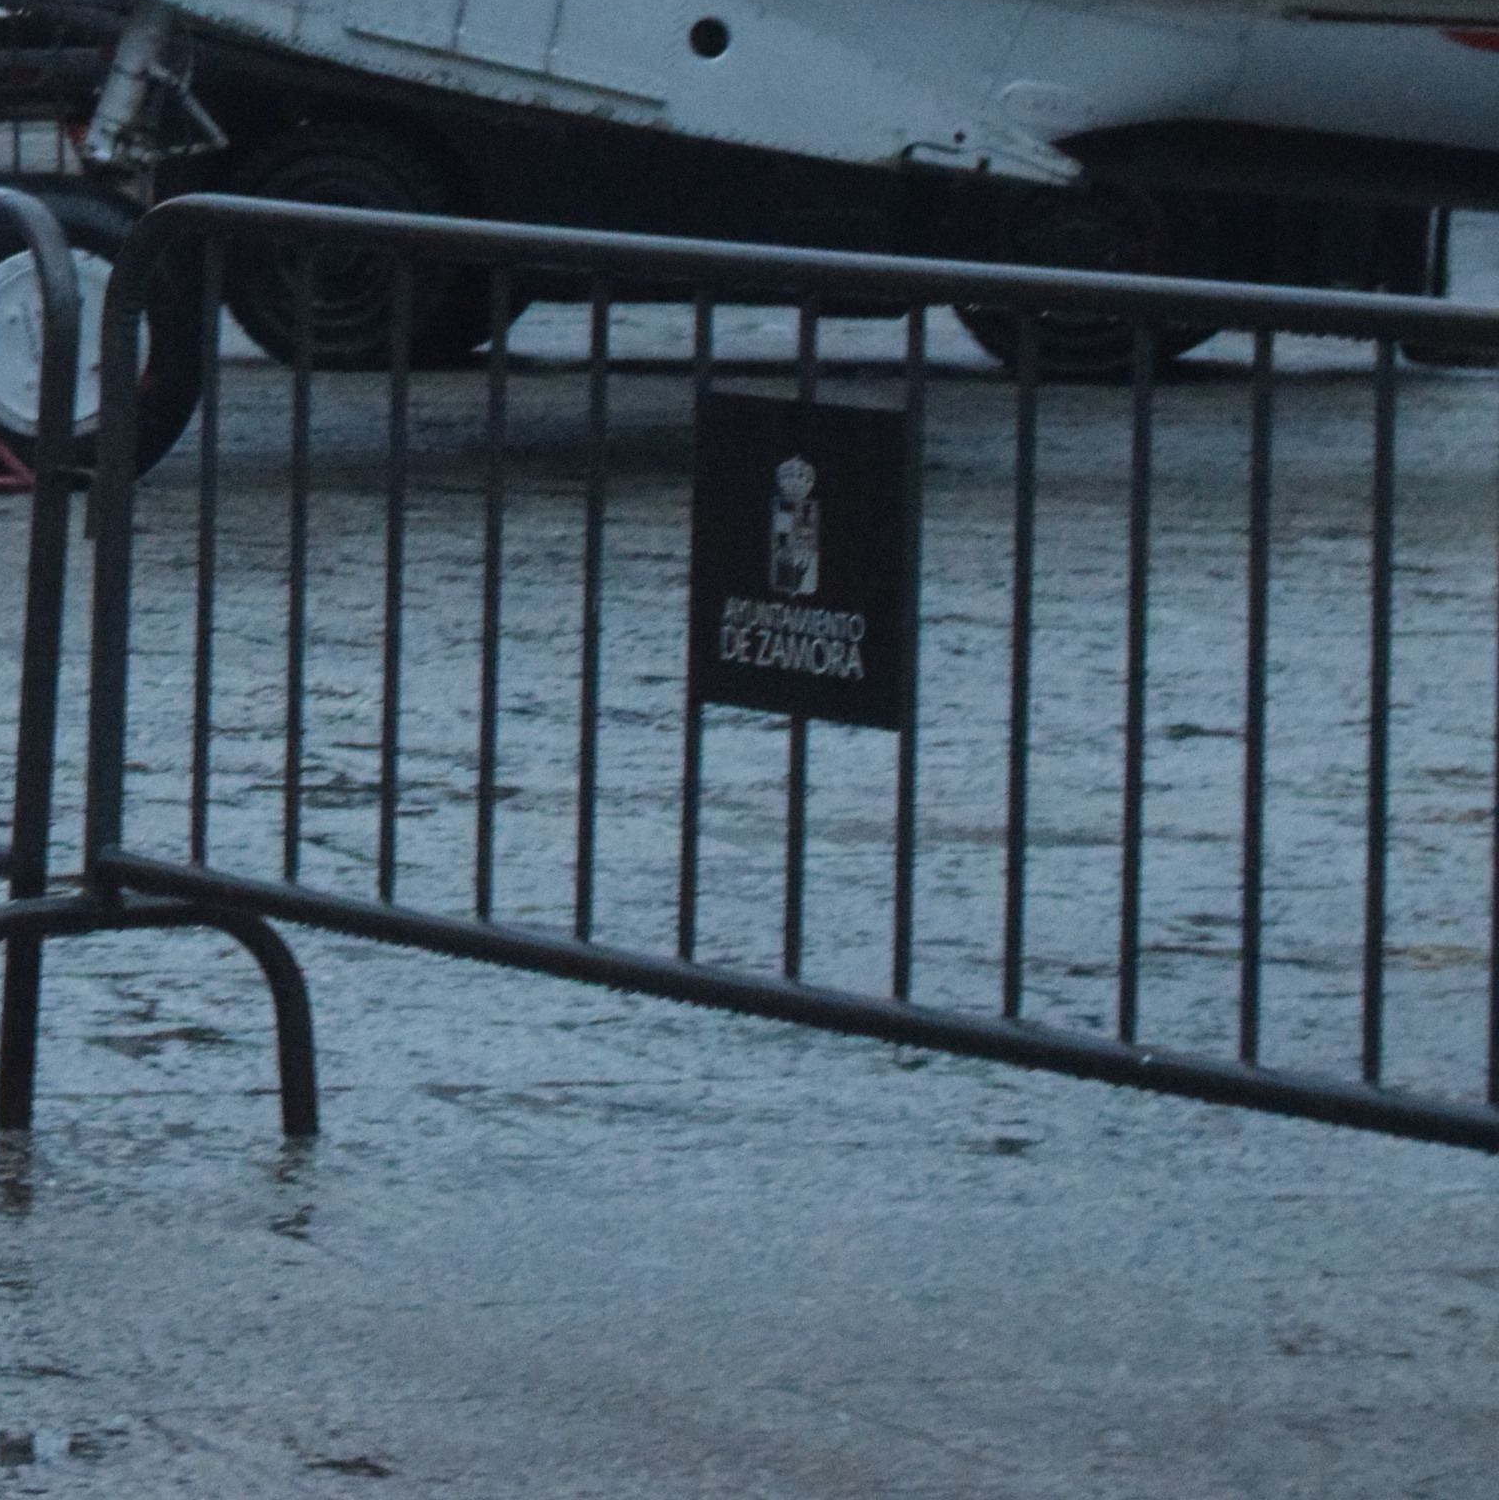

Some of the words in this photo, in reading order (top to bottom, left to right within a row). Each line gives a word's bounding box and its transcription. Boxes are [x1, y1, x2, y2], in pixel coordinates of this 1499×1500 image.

[723, 596, 865, 642] AYUNTAMIENTO
[720, 625, 750, 662] DE
[755, 629, 864, 679] ZAMORA
